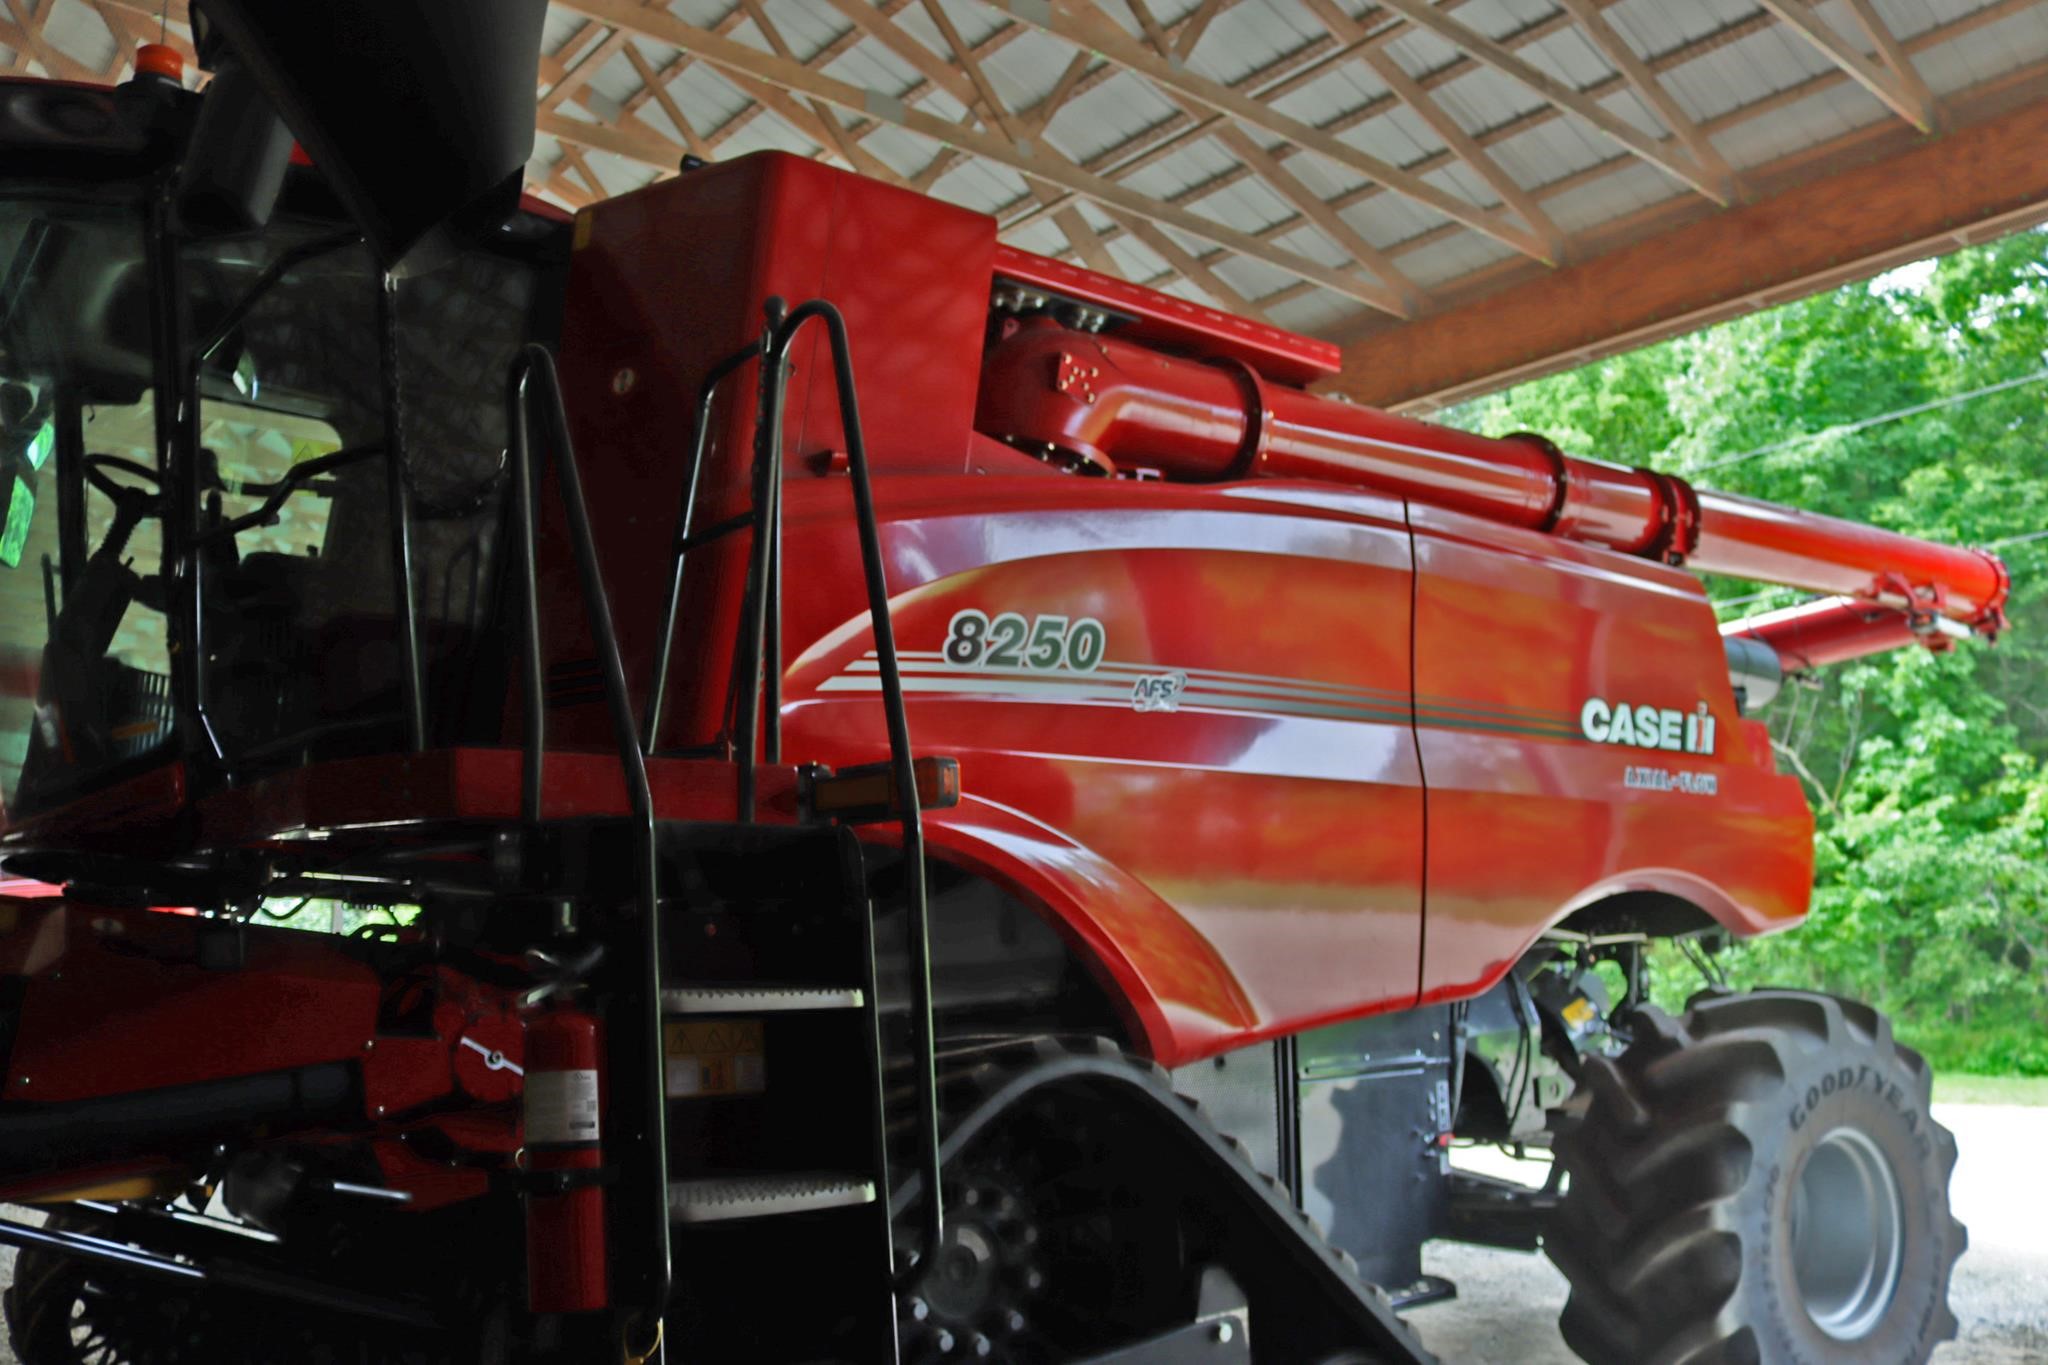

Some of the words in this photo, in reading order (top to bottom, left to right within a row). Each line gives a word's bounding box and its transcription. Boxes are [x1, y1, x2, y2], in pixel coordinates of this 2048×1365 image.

[943, 609, 1105, 672] 8250
[1133, 675, 1174, 699] AFS
[1581, 697, 1684, 751] CASE
